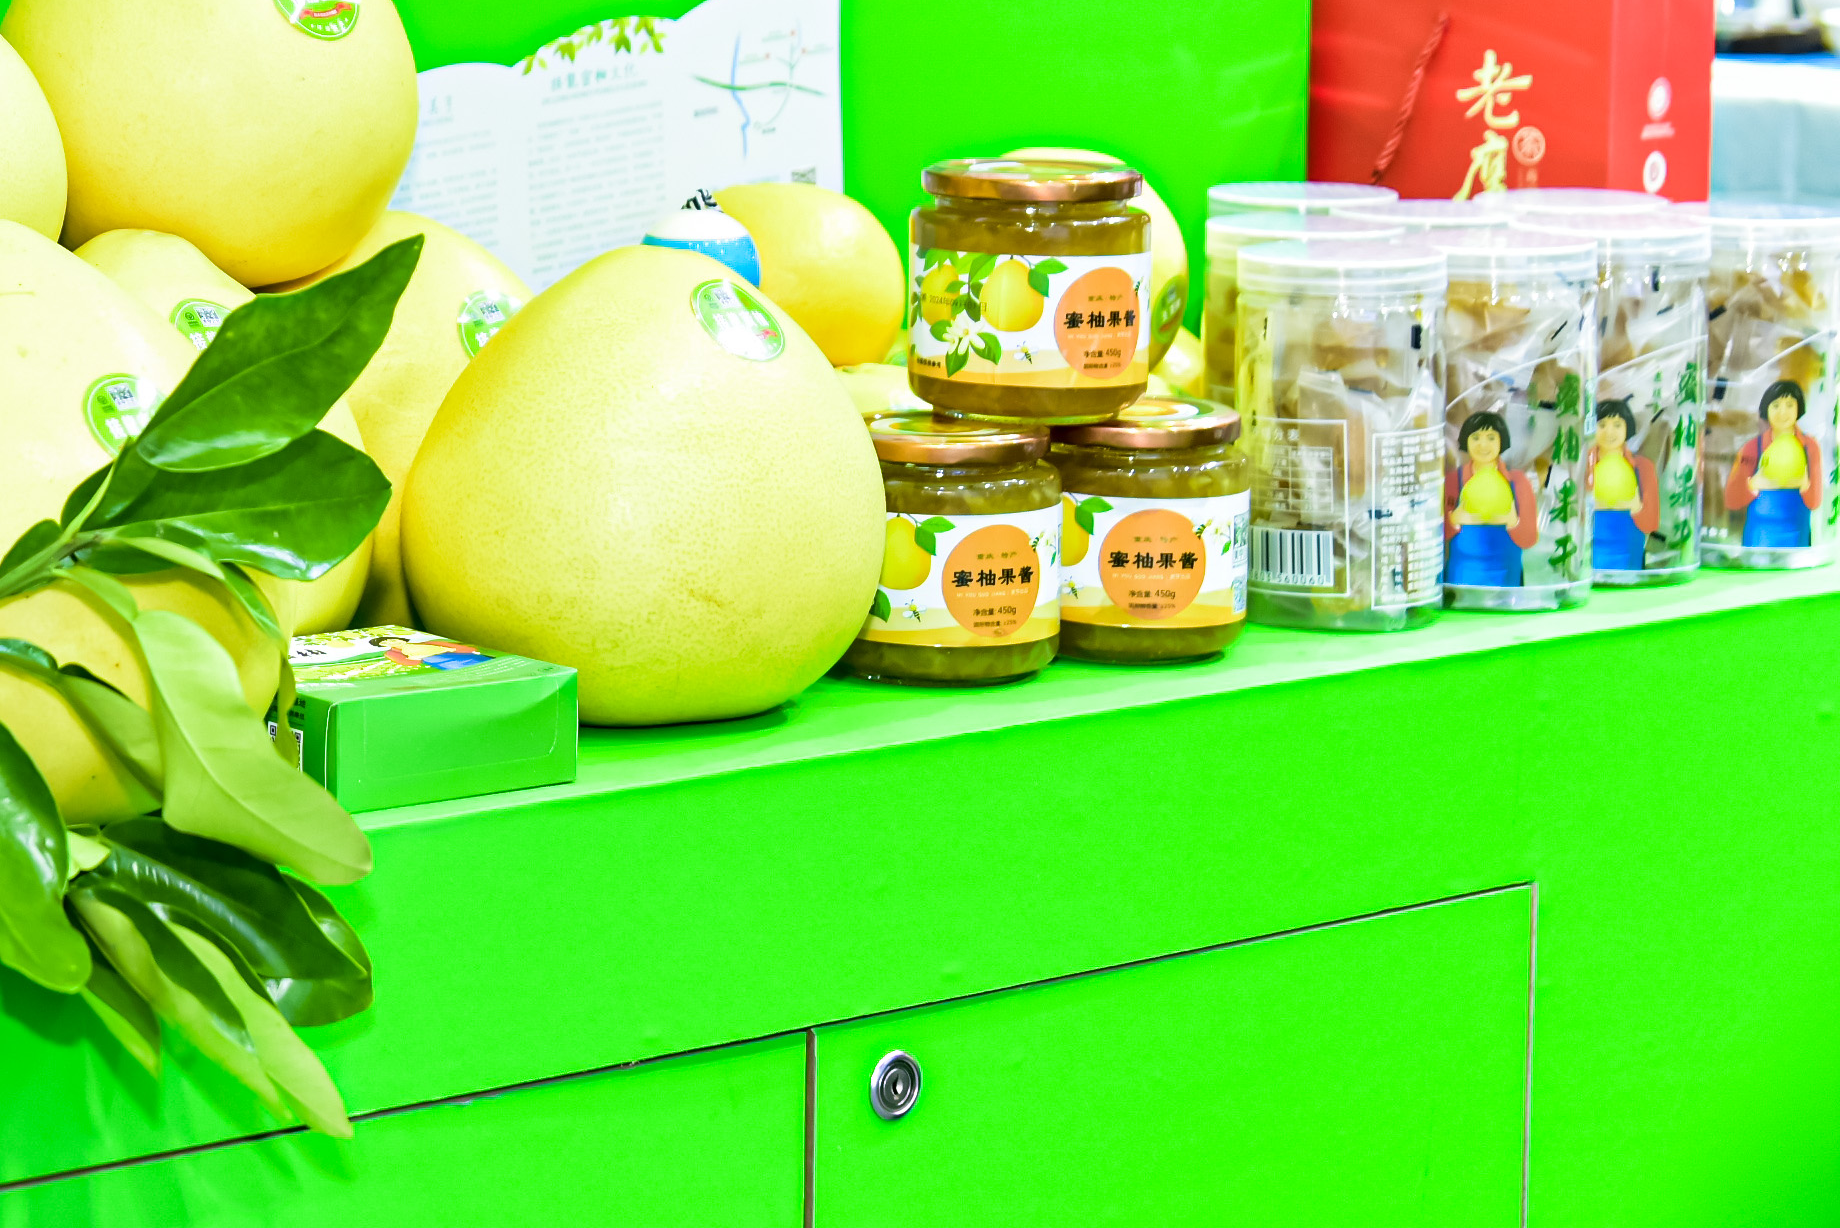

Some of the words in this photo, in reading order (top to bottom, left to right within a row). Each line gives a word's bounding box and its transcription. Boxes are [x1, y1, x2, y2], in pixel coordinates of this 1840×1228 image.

[1063, 309, 1136, 330] 蜜柚果酱
[1107, 550, 1199, 570] 蜜柚果酱
[951, 565, 1034, 588] 蜜柚果酱
[1154, 589, 1176, 599] 450g
[997, 606, 1017, 615] 450g
